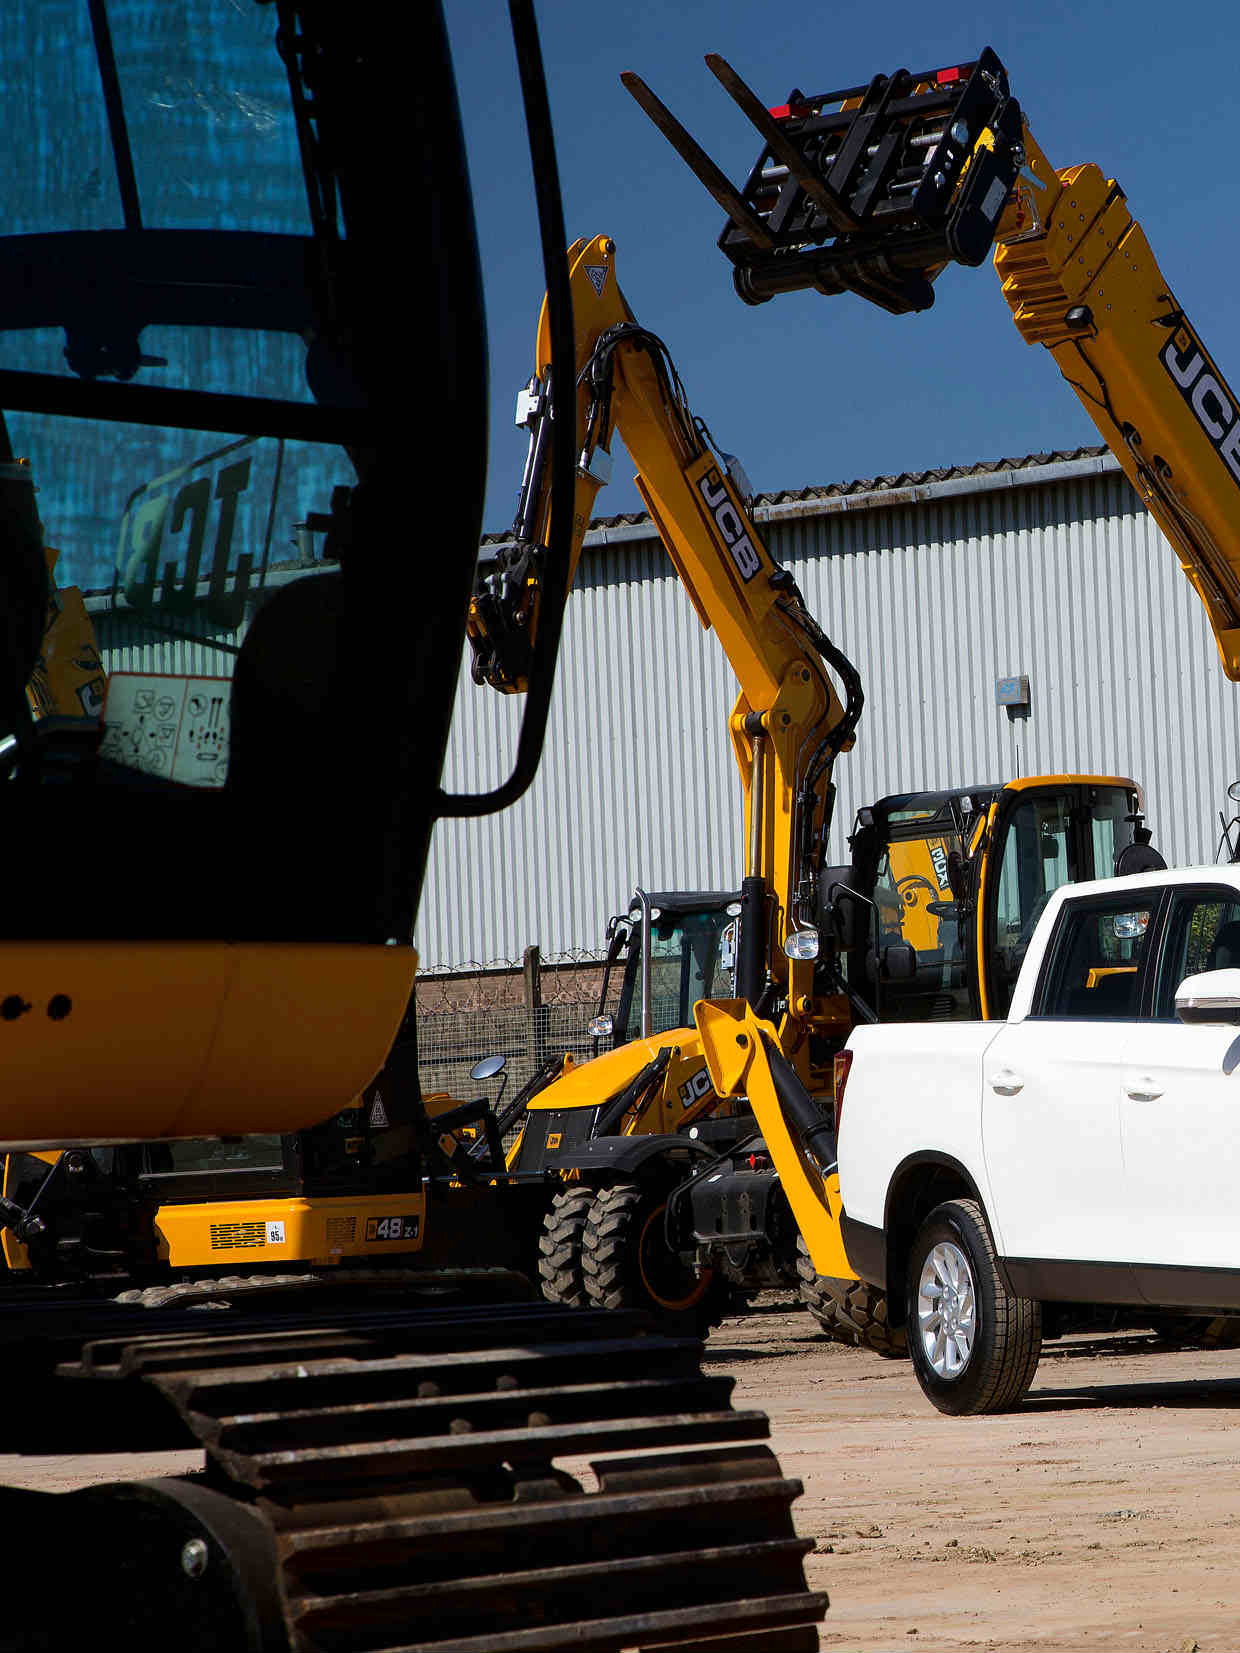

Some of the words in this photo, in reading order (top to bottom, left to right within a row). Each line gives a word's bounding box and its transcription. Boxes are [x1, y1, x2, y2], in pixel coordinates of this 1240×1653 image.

[700, 478, 760, 579] JCB
[682, 1069, 712, 1107] JC
[377, 1218, 401, 1239] 48
